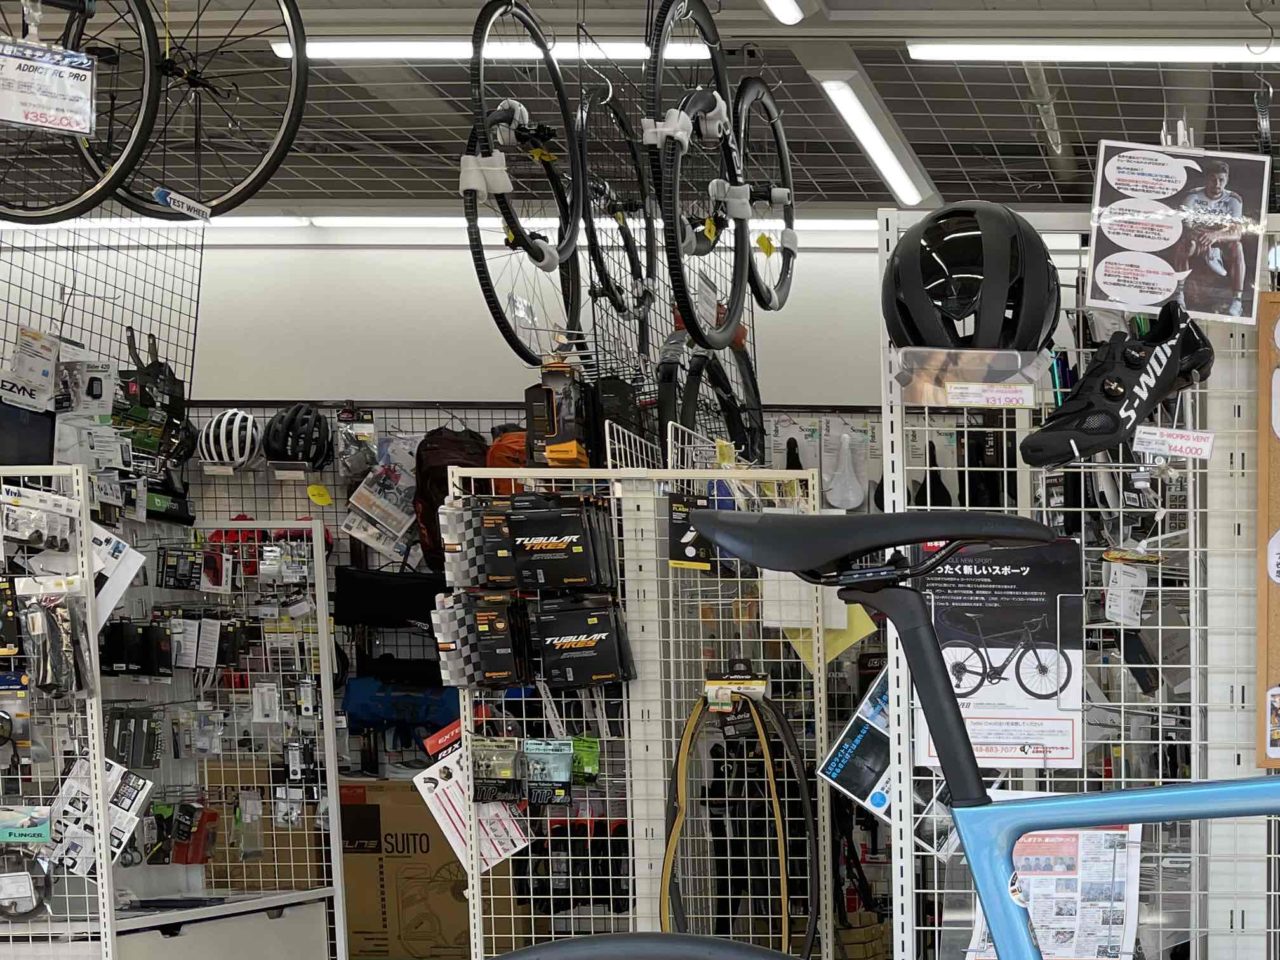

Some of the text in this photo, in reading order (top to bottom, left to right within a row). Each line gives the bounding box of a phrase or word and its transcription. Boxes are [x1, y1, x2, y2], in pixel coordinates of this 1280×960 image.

[16, 63, 48, 76] ADDICT
[68, 72, 87, 82] PRO
[169, 197, 208, 219] TEST WHEEL
[0, 380, 37, 399] EZYNE
[515, 534, 581, 545] TUBULAR
[524, 541, 570, 550] TIRES
[931, 564, 1030, 576] ったく新しいスポーツ
[544, 632, 609, 645] TUBULAR
[384, 833, 430, 854] SUITO
